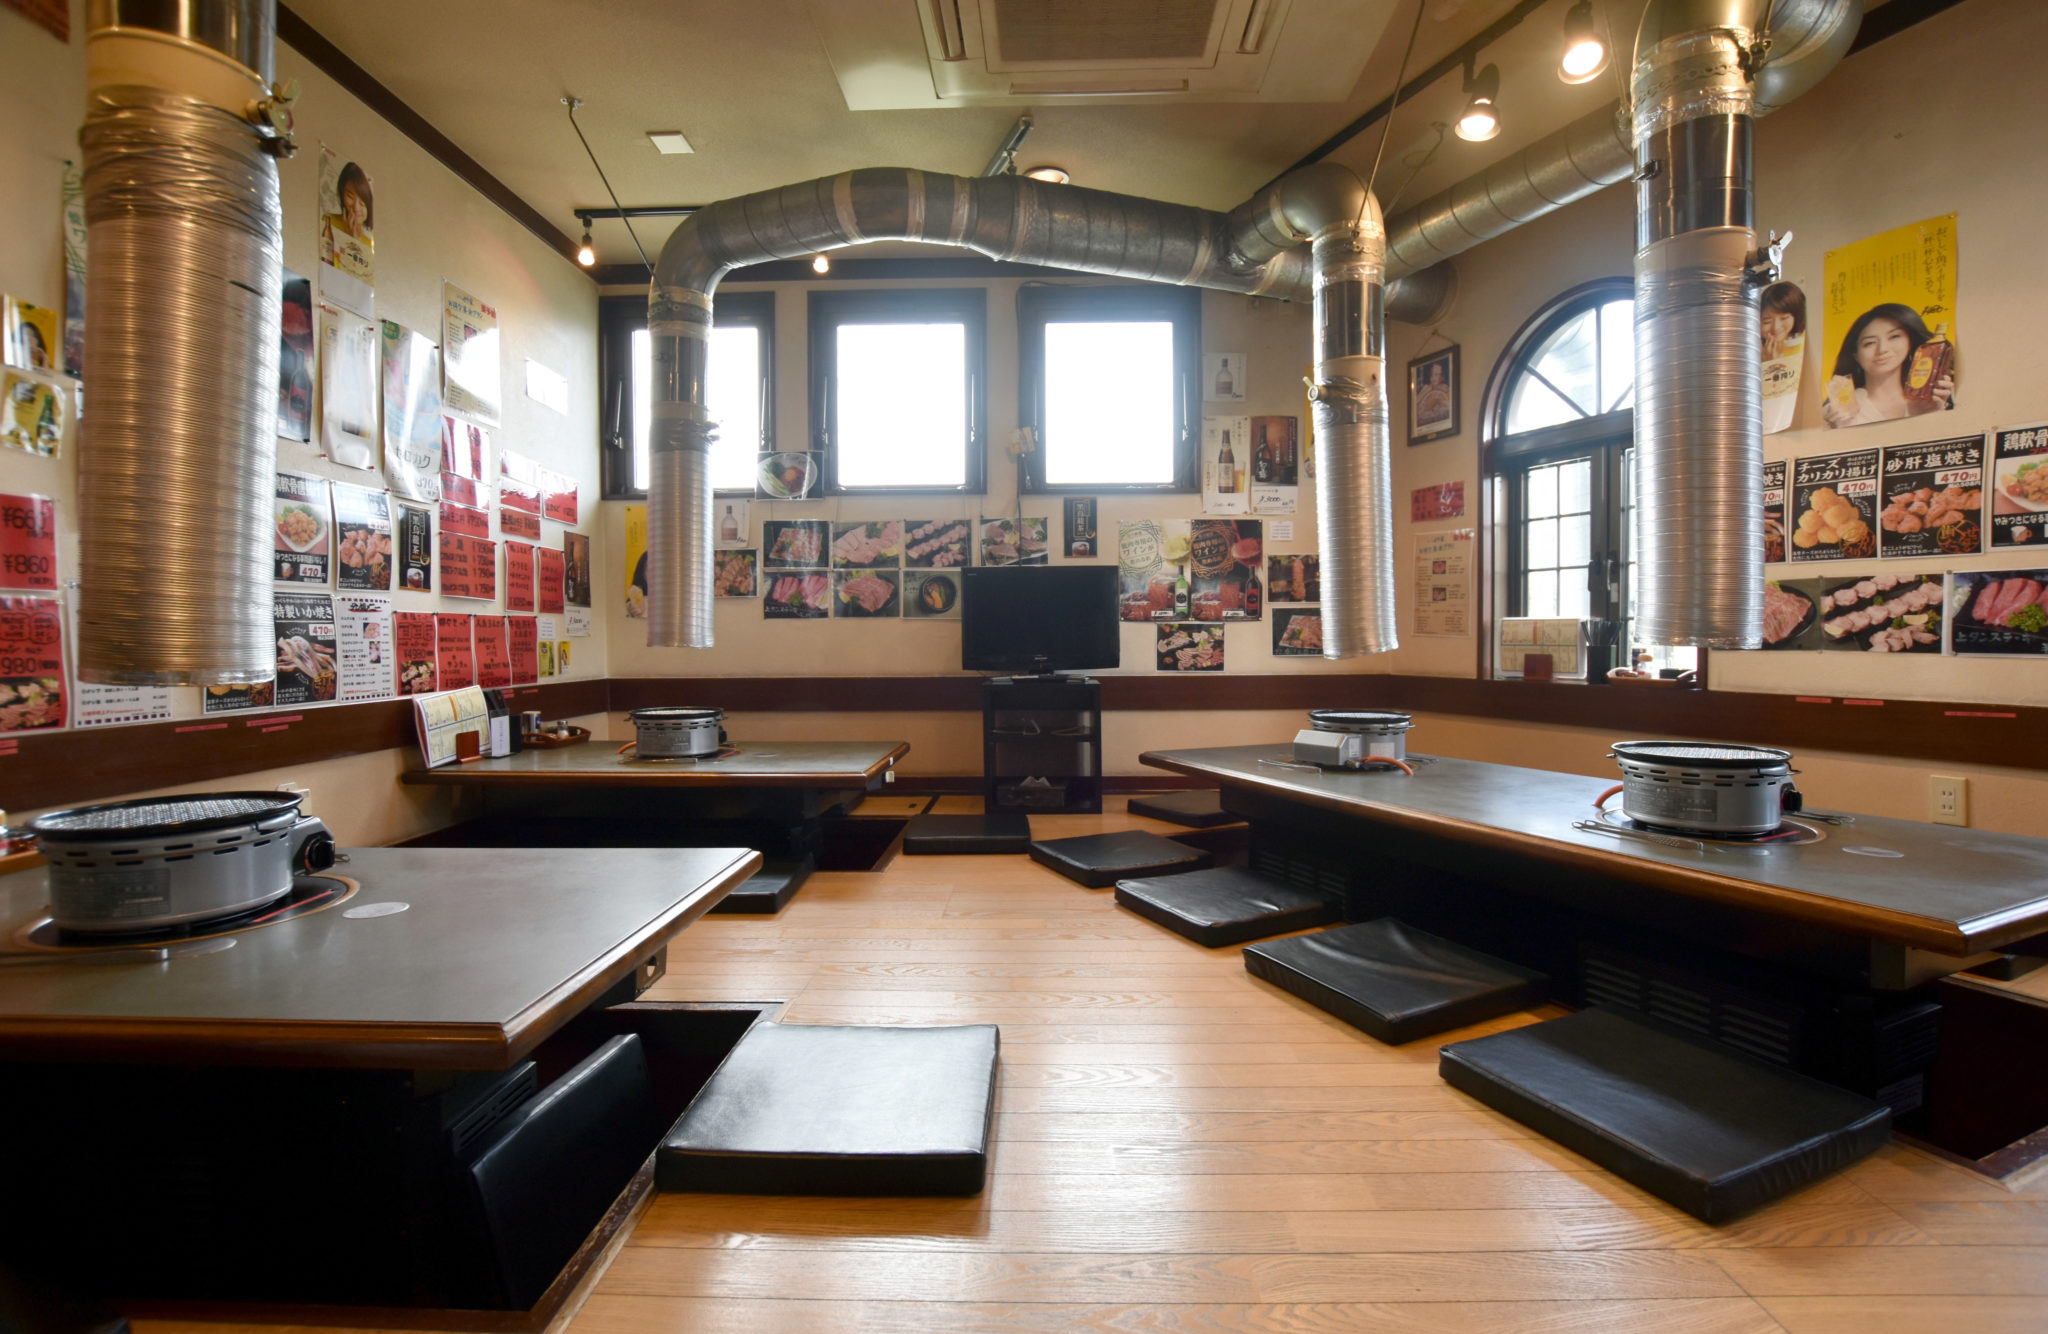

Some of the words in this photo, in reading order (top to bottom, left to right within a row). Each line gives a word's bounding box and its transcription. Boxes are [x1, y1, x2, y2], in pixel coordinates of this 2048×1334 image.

[1798, 457, 1841, 473] チーズ
[1885, 448, 1980, 472] 砂肝塩焼き
[1796, 464, 1878, 483] カリカリ揚げ
[1941, 471, 1978, 483] 470円
[1842, 482, 1874, 493] 470円
[3, 553, 49, 575] ¥860
[302, 567, 319, 577] 470
[274, 602, 333, 619] 特製いか焼き
[312, 626, 333, 635] 470円
